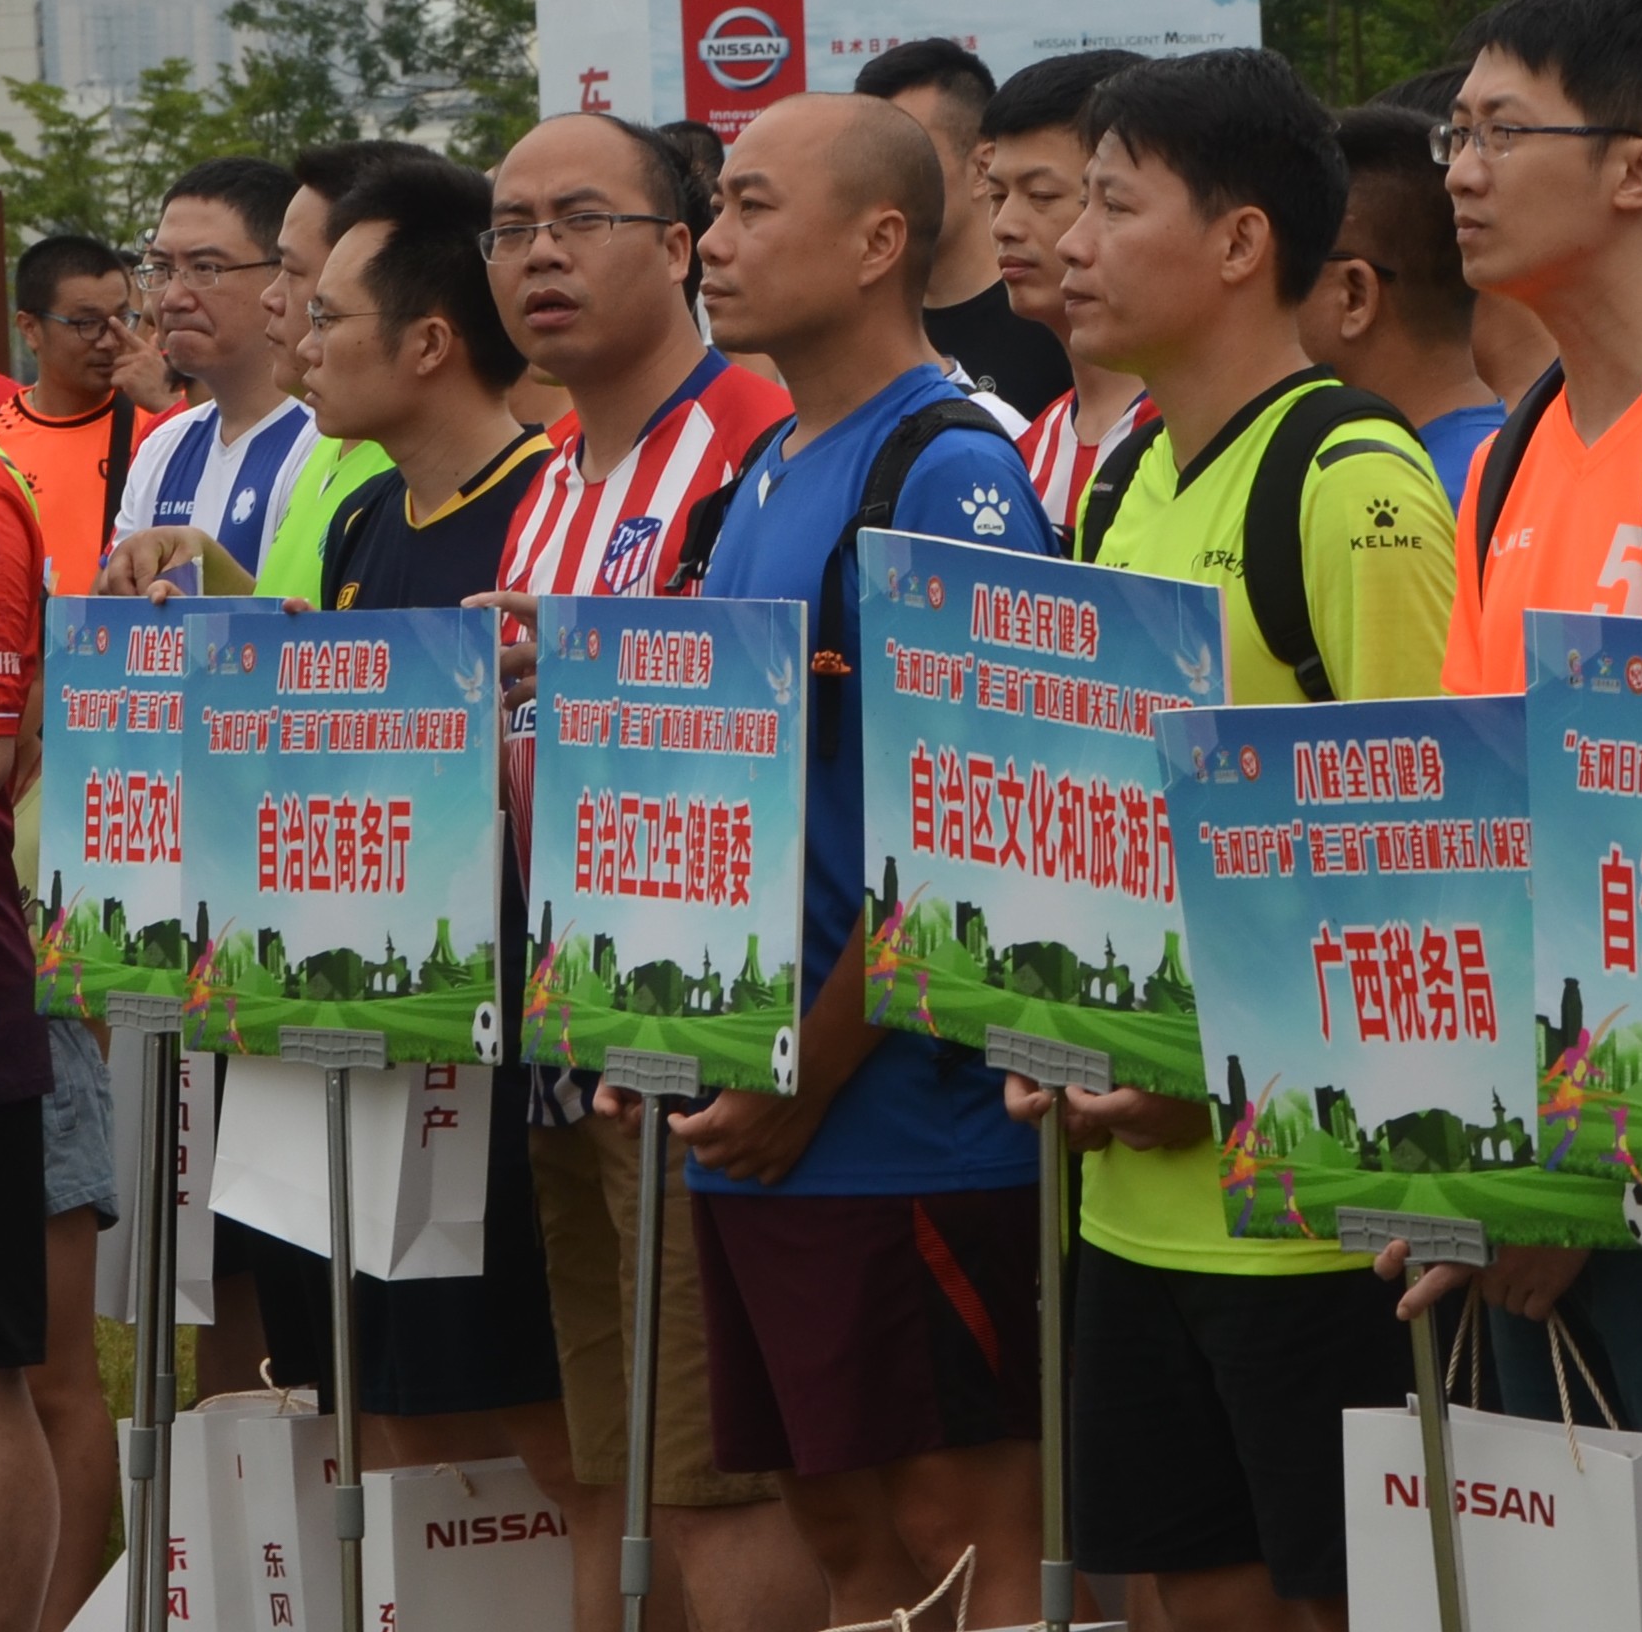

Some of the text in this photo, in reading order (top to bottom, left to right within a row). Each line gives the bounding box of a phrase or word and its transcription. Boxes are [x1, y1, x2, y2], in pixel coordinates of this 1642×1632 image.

[707, 42, 781, 57] NISSAN
[1351, 533, 1423, 551] KELME
[617, 628, 713, 689] 八桂全民健身
[970, 582, 1099, 662] 八桂全民健身
[276, 639, 390, 695] 八桂全民健身
[885, 638, 1194, 741] “东风日产杯”第三届广西区直机关五人制
[1293, 736, 1444, 805] 八桂全民健身
[257, 790, 413, 896] 自治区商务厅
[574, 785, 753, 908] 自治区卫生健康委
[910, 738, 1176, 906] 自治区文化和旅游厅
[1199, 818, 1533, 878] “东风日产杯”第三届广西区直机关五人制足
[1311, 920, 1499, 1045] 广西税务局
[1384, 1472, 1555, 1528] NSAN
[262, 1542, 294, 1628] 东风
